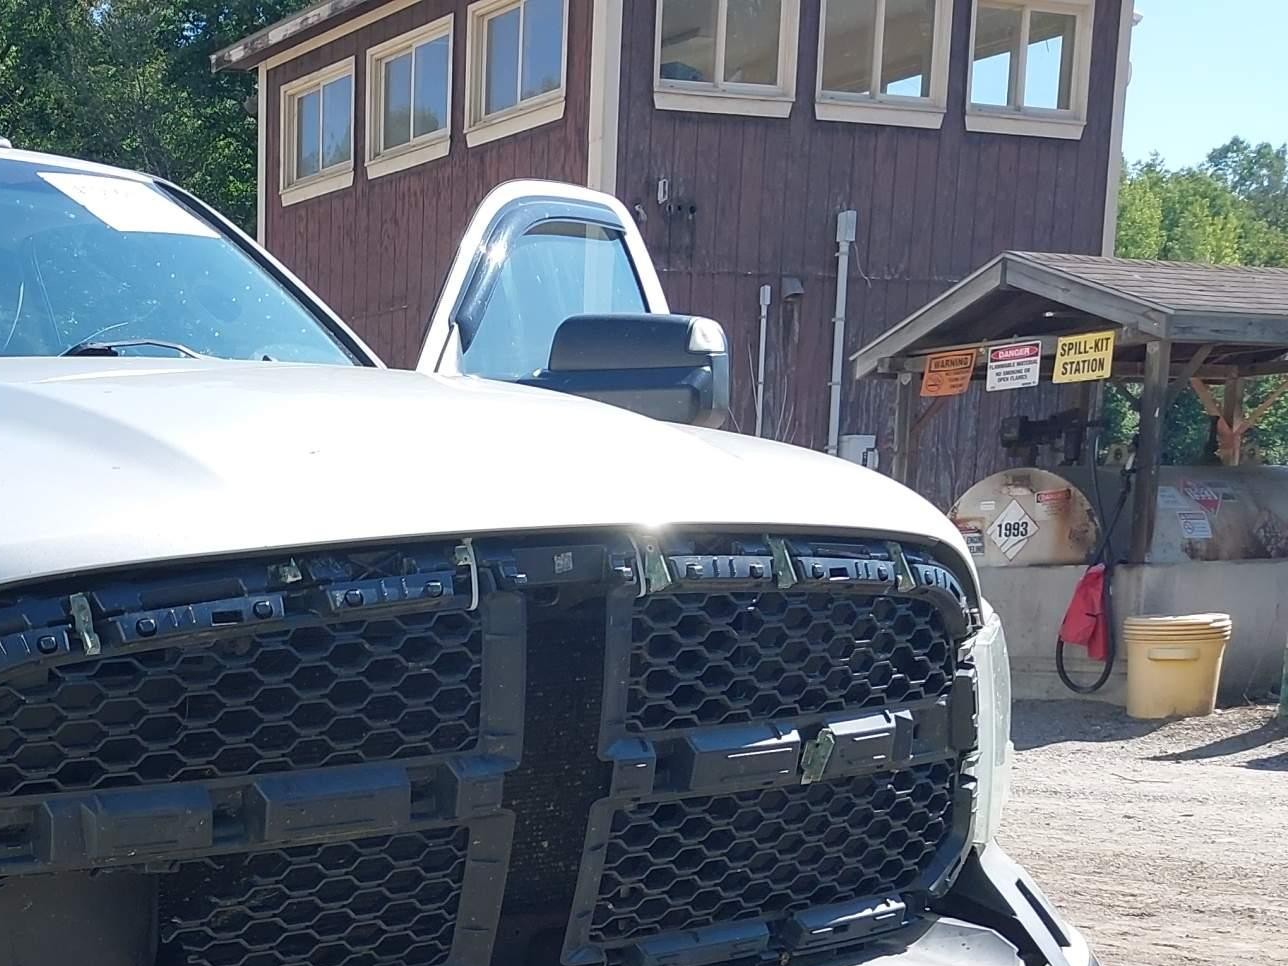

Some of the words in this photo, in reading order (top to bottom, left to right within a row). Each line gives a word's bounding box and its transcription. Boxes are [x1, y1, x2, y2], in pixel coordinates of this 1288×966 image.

[998, 347, 1030, 358] DANGER
[1060, 337, 1111, 357] SPILL-KIT
[933, 356, 969, 369] WARNING
[1061, 358, 1105, 376] STATION
[997, 521, 1029, 538] 1993
